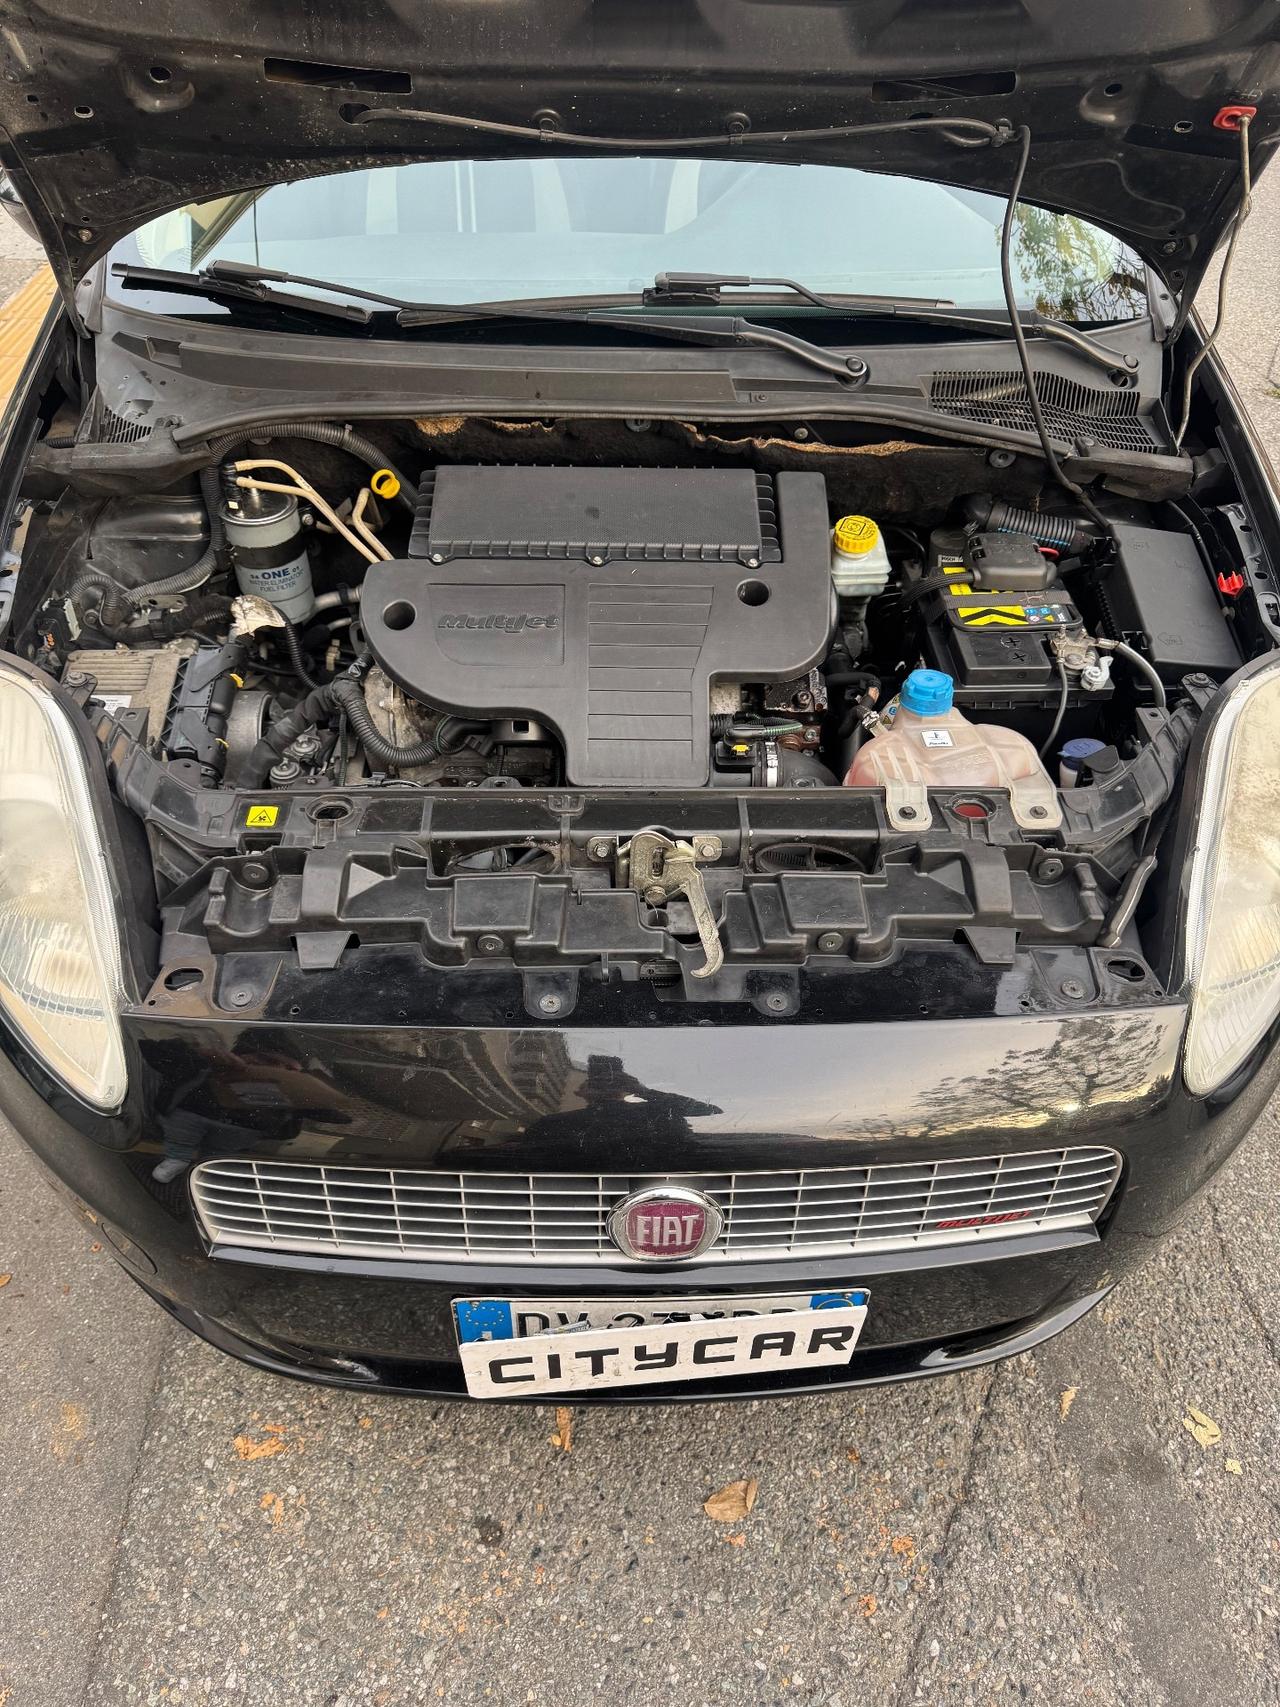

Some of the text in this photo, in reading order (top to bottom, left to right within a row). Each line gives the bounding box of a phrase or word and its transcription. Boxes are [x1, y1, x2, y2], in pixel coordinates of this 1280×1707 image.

[261, 567, 291, 580] ONE
[270, 568, 304, 586] ELIMINATOR
[276, 580, 297, 590] FILTER
[636, 1214, 700, 1247] FIAT
[488, 1325, 855, 1384] CITYCAR
